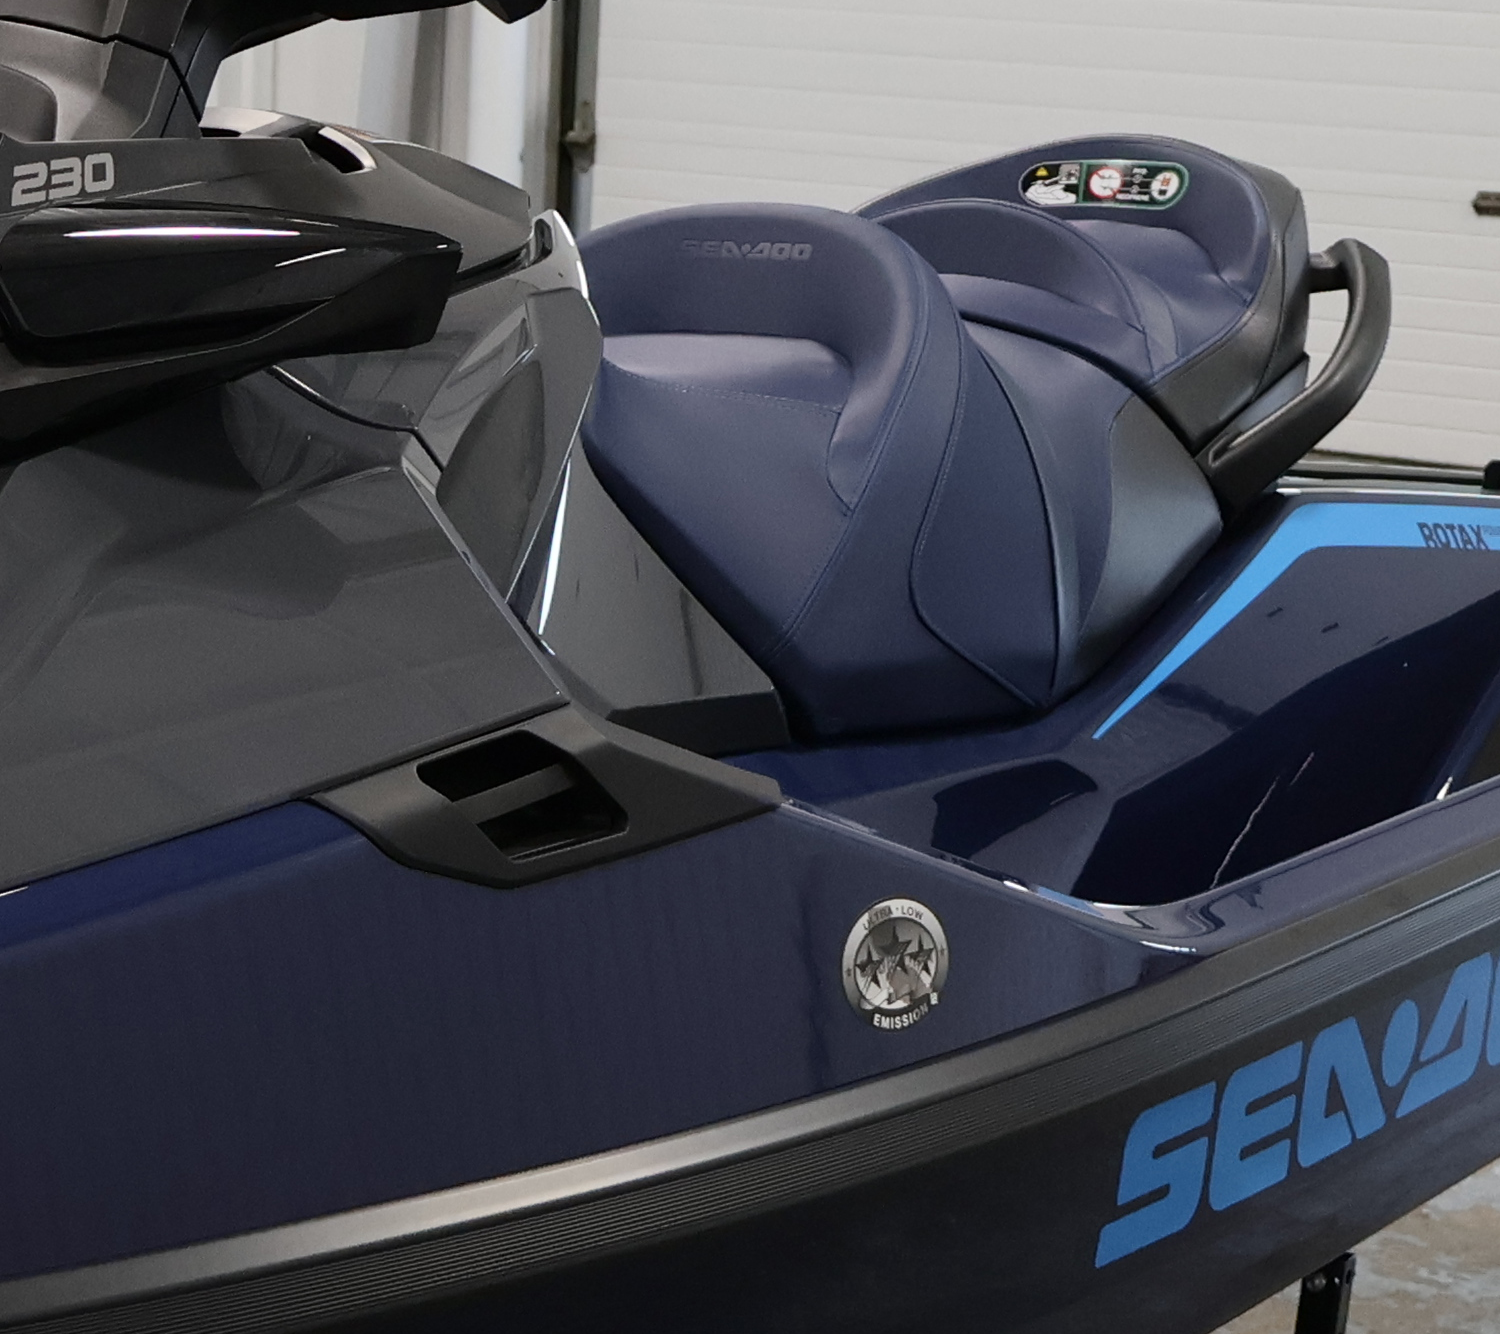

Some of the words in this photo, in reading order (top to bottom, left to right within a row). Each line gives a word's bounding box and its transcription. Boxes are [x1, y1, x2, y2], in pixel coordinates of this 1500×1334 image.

[11, 152, 115, 208] 230
[1416, 521, 1491, 552] ROTAX
[900, 904, 924, 921] LOW
[872, 1003, 930, 1030] EMISSION
